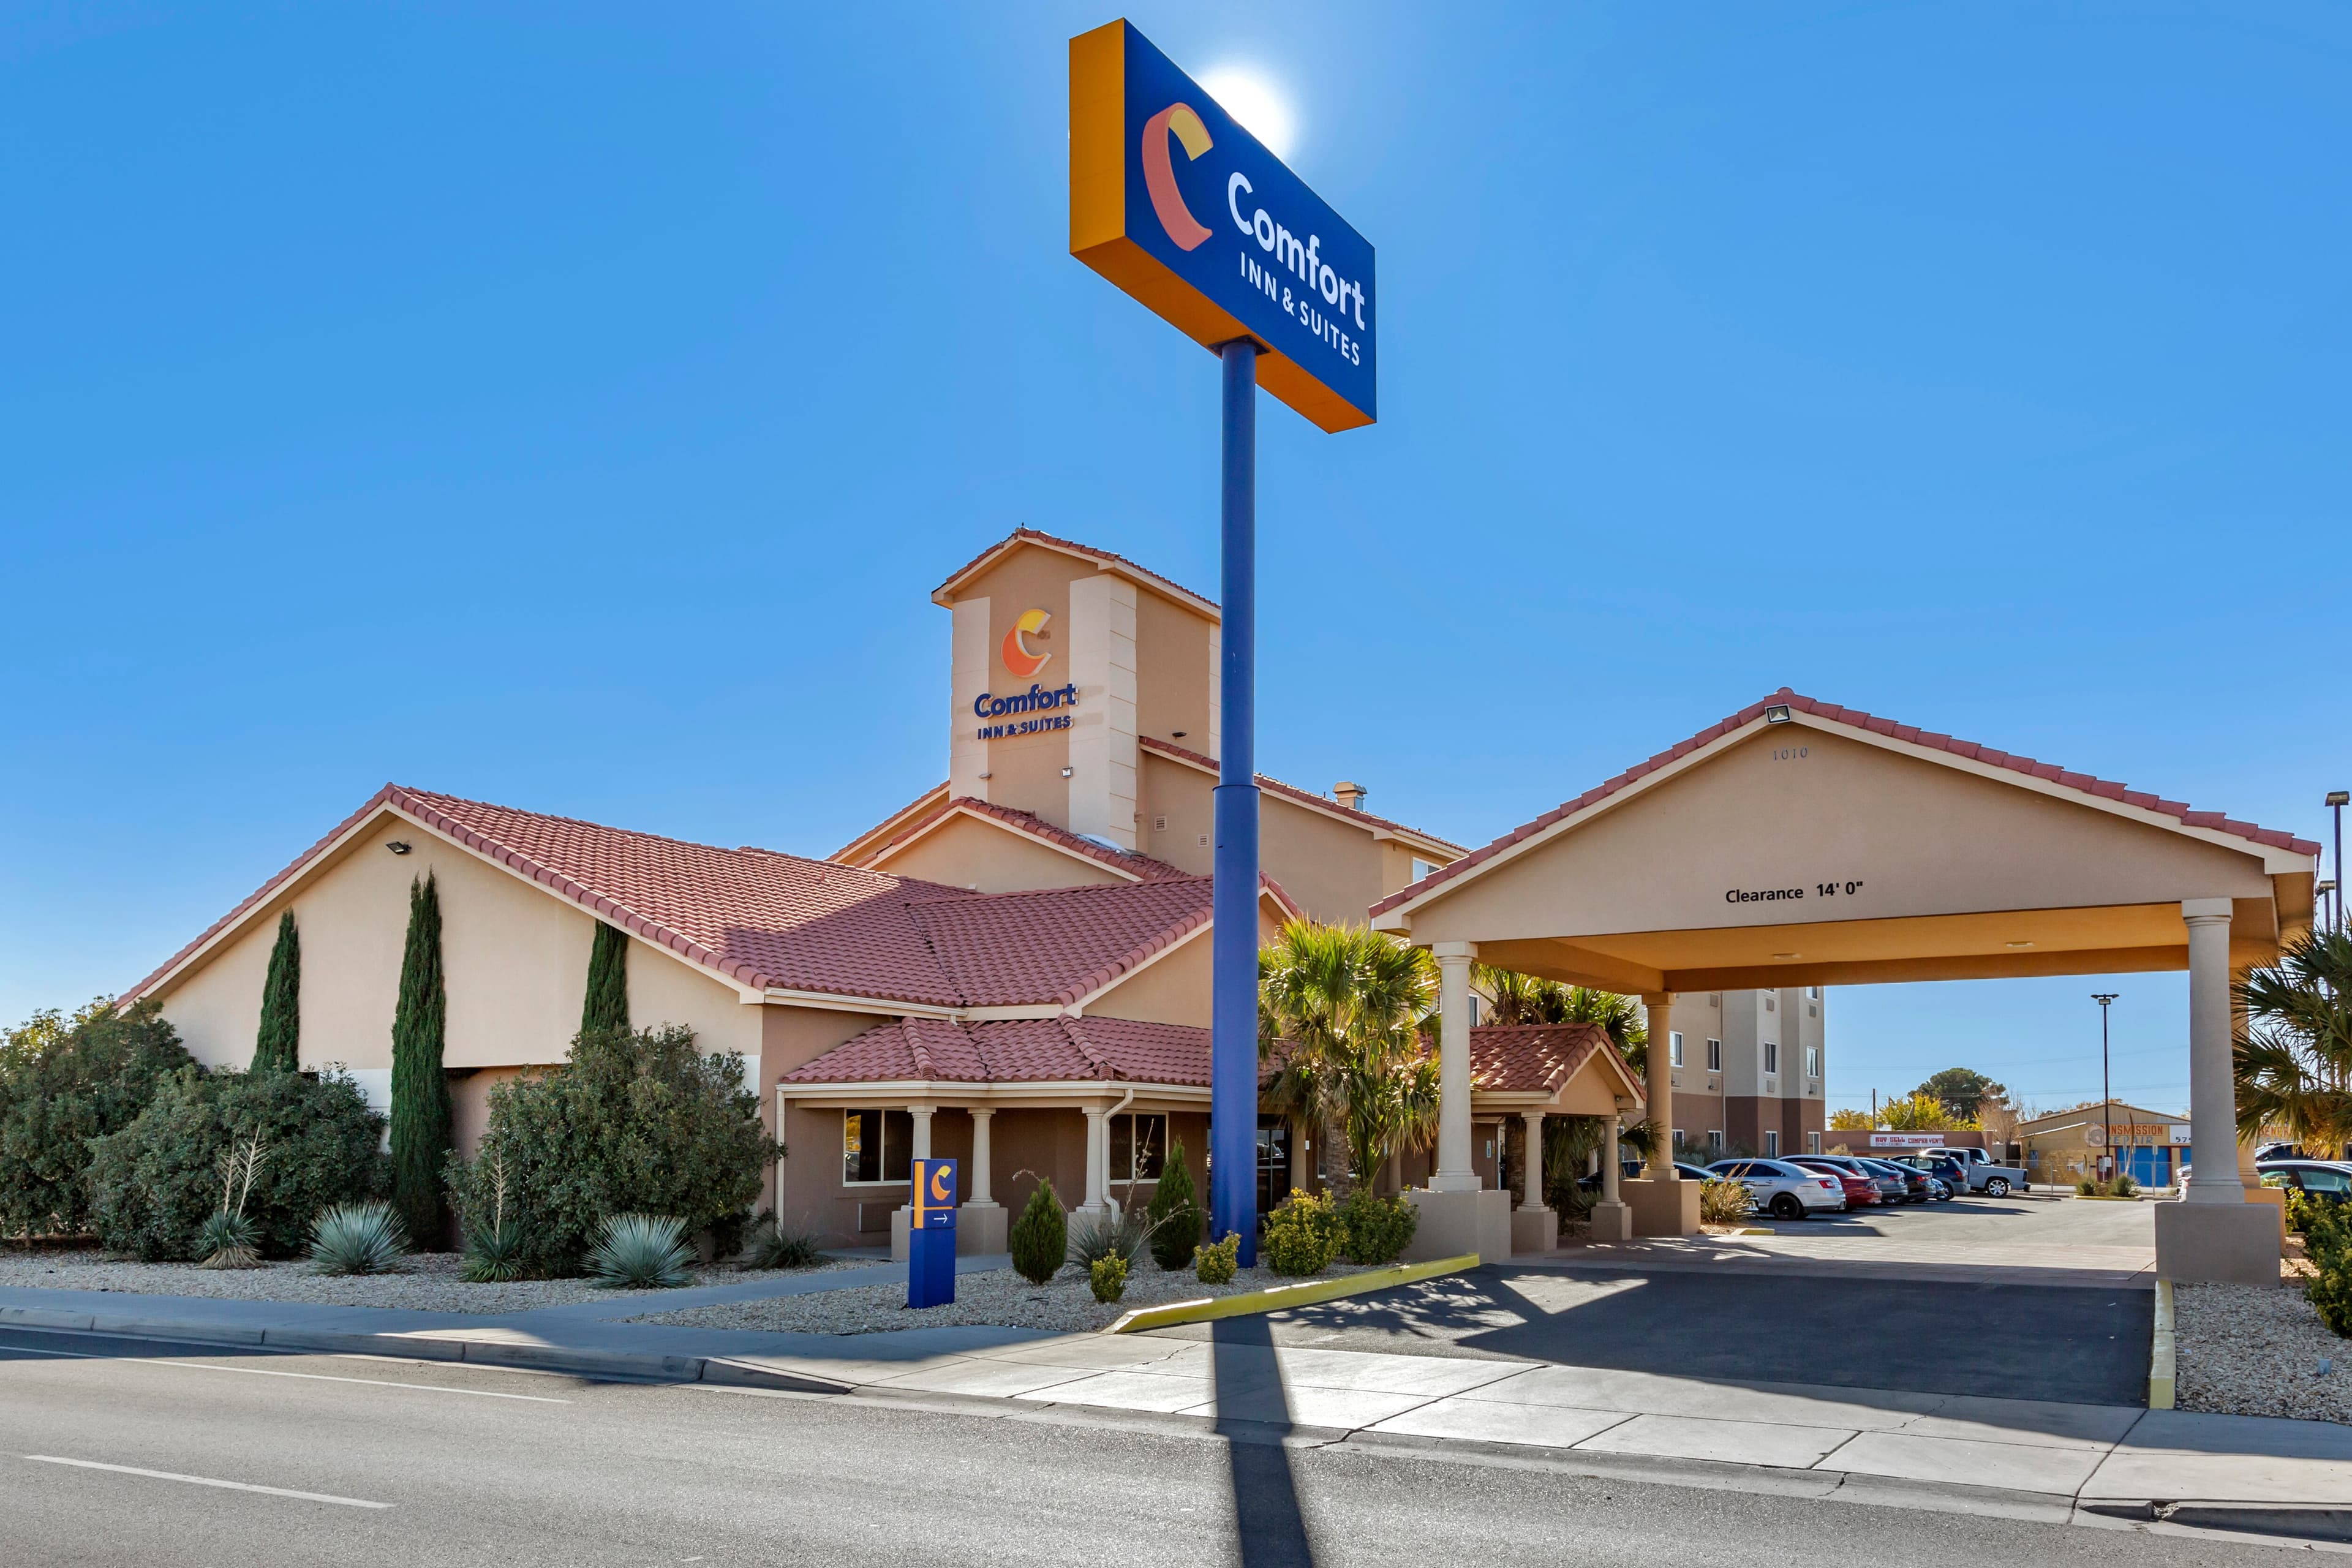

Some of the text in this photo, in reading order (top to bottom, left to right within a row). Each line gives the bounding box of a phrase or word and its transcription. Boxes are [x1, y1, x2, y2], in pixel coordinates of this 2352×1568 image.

[1228, 172, 1365, 331] Comfort
[1241, 251, 1360, 367] INN & SUITES
[974, 683, 1078, 718] Comfort
[978, 715, 1073, 739] INN & SUITES
[1773, 747, 1807, 761] 1010
[1725, 881, 1863, 903] Clearance 14' 0"
